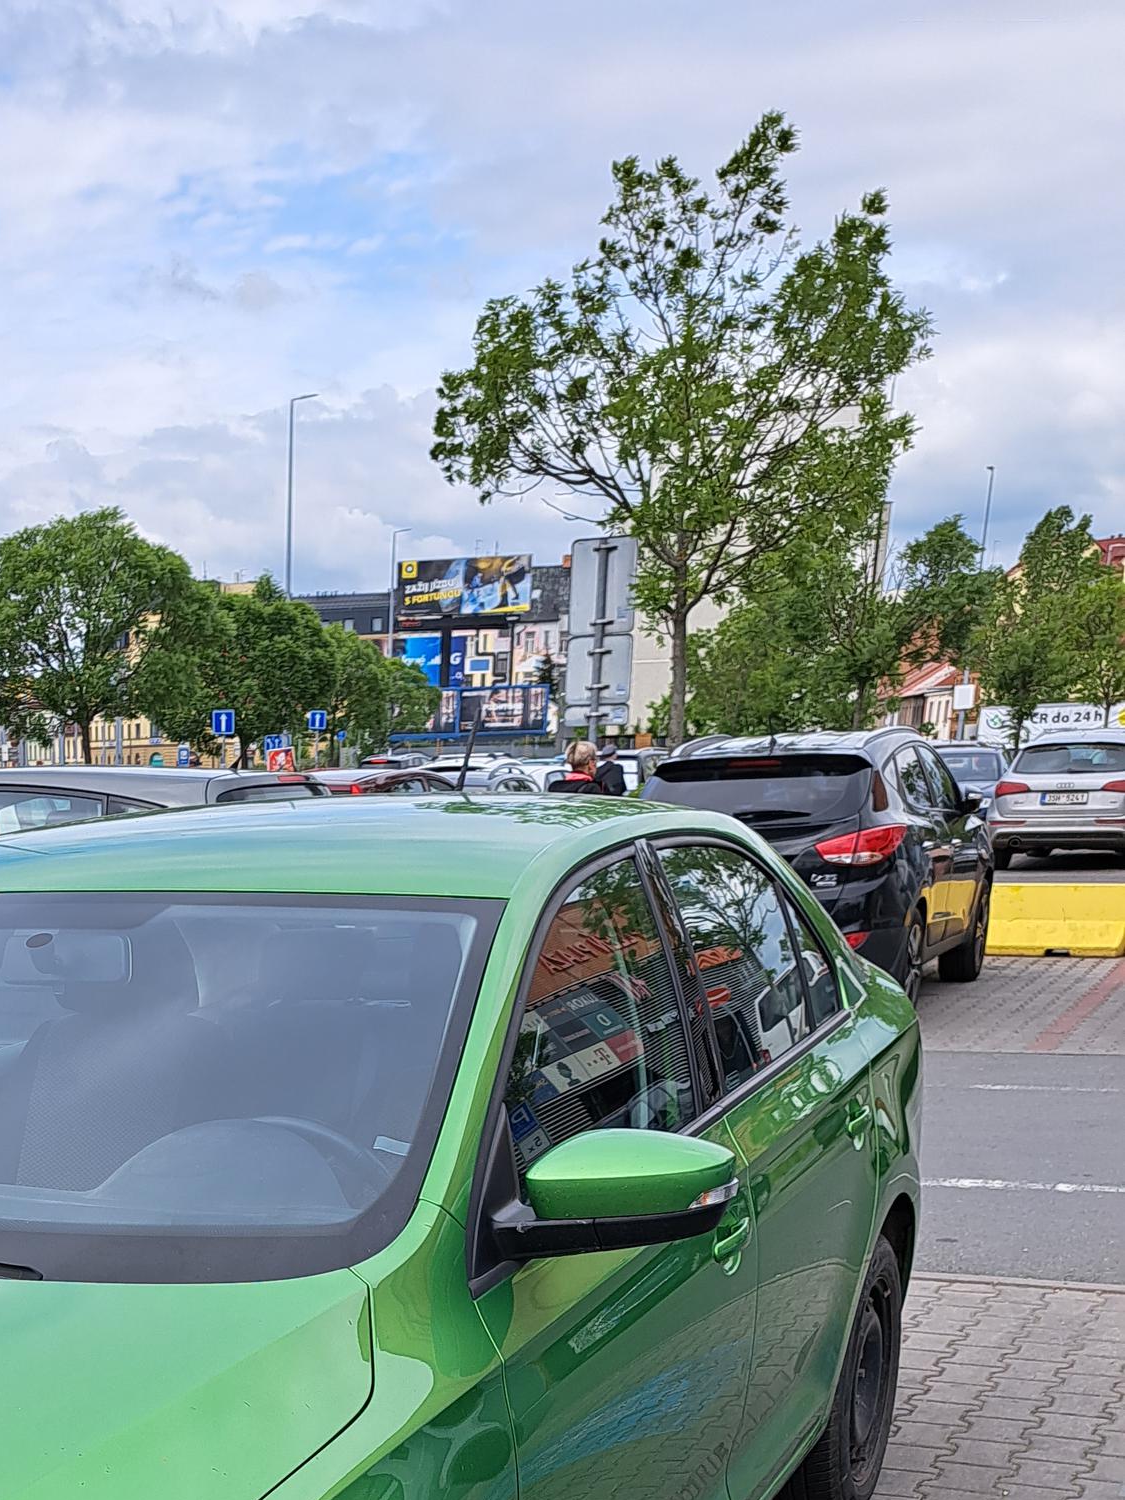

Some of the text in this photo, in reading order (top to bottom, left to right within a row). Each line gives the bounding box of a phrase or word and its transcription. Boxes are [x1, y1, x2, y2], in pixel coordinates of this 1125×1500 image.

[1052, 712, 1070, 724] do
[1073, 712, 1091, 723] 24
[1094, 710, 1103, 722] h
